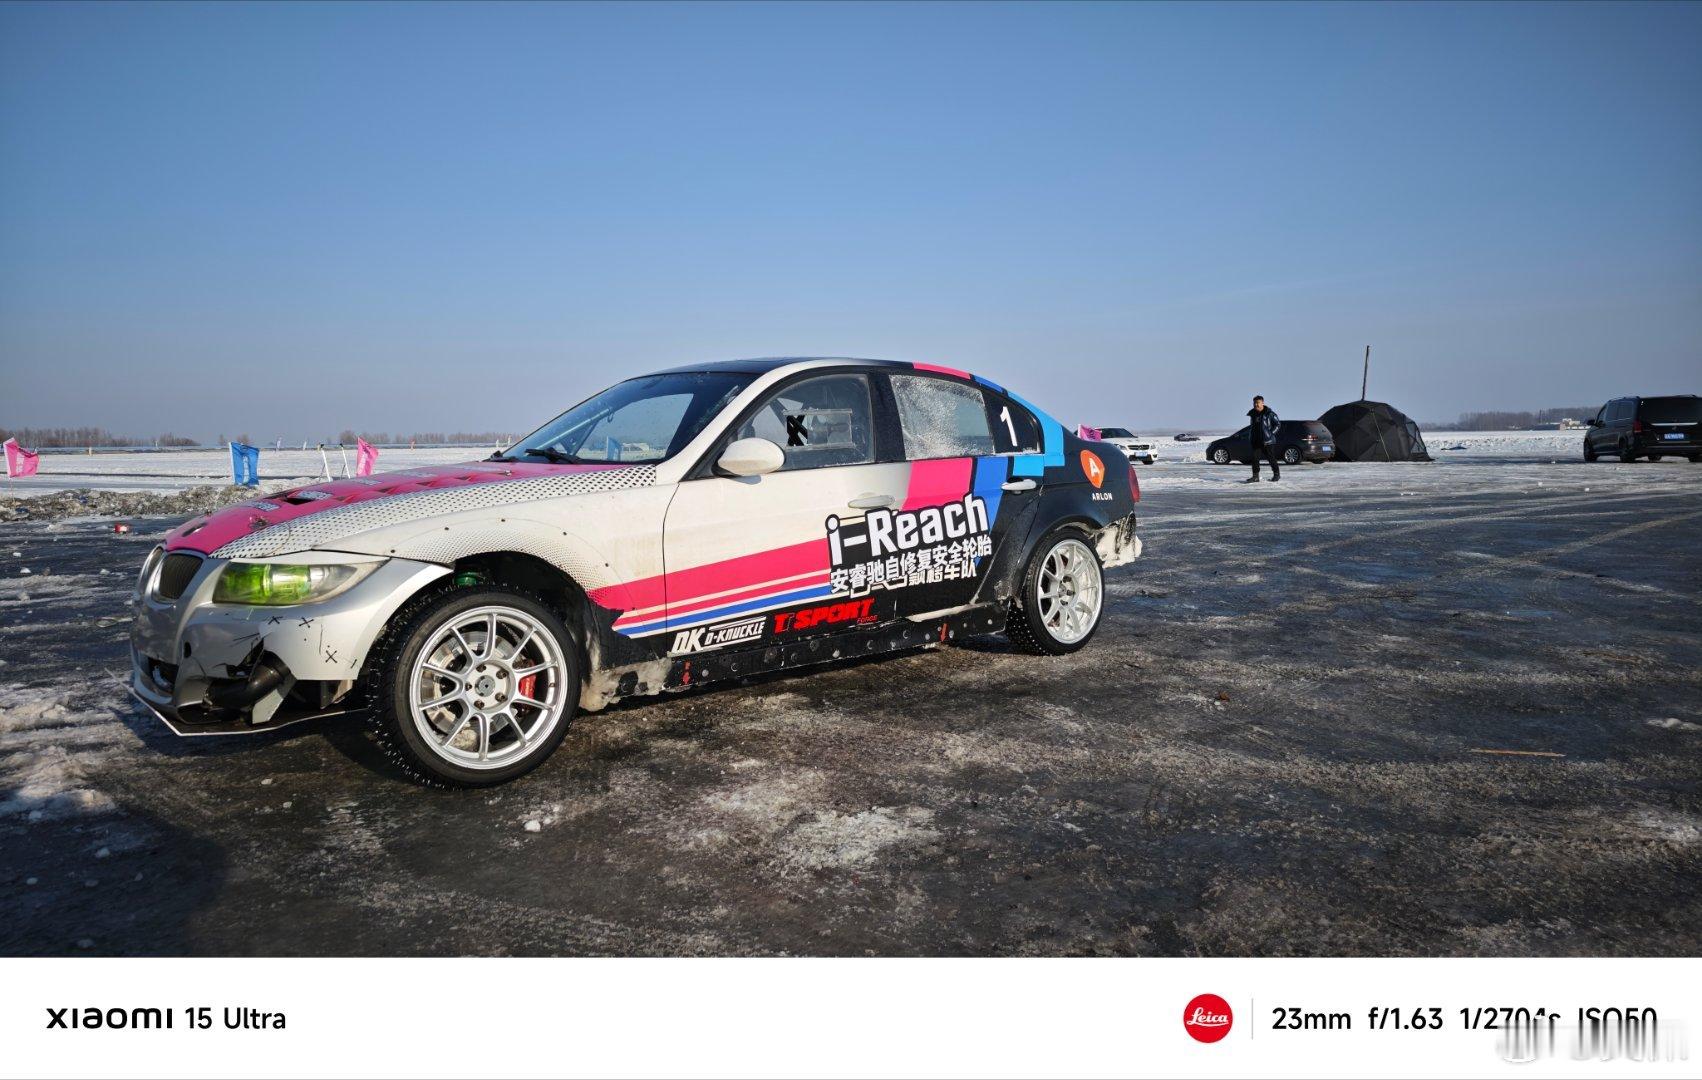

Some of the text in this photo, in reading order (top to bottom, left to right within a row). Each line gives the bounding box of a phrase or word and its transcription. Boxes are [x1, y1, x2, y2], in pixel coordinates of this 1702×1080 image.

[1000, 406, 1018, 447] 1
[1091, 492, 1113, 501] ARLON
[827, 493, 989, 566] i-Reach
[830, 534, 993, 594] 安睿驰自修复安全轮胎
[671, 627, 706, 653] DK
